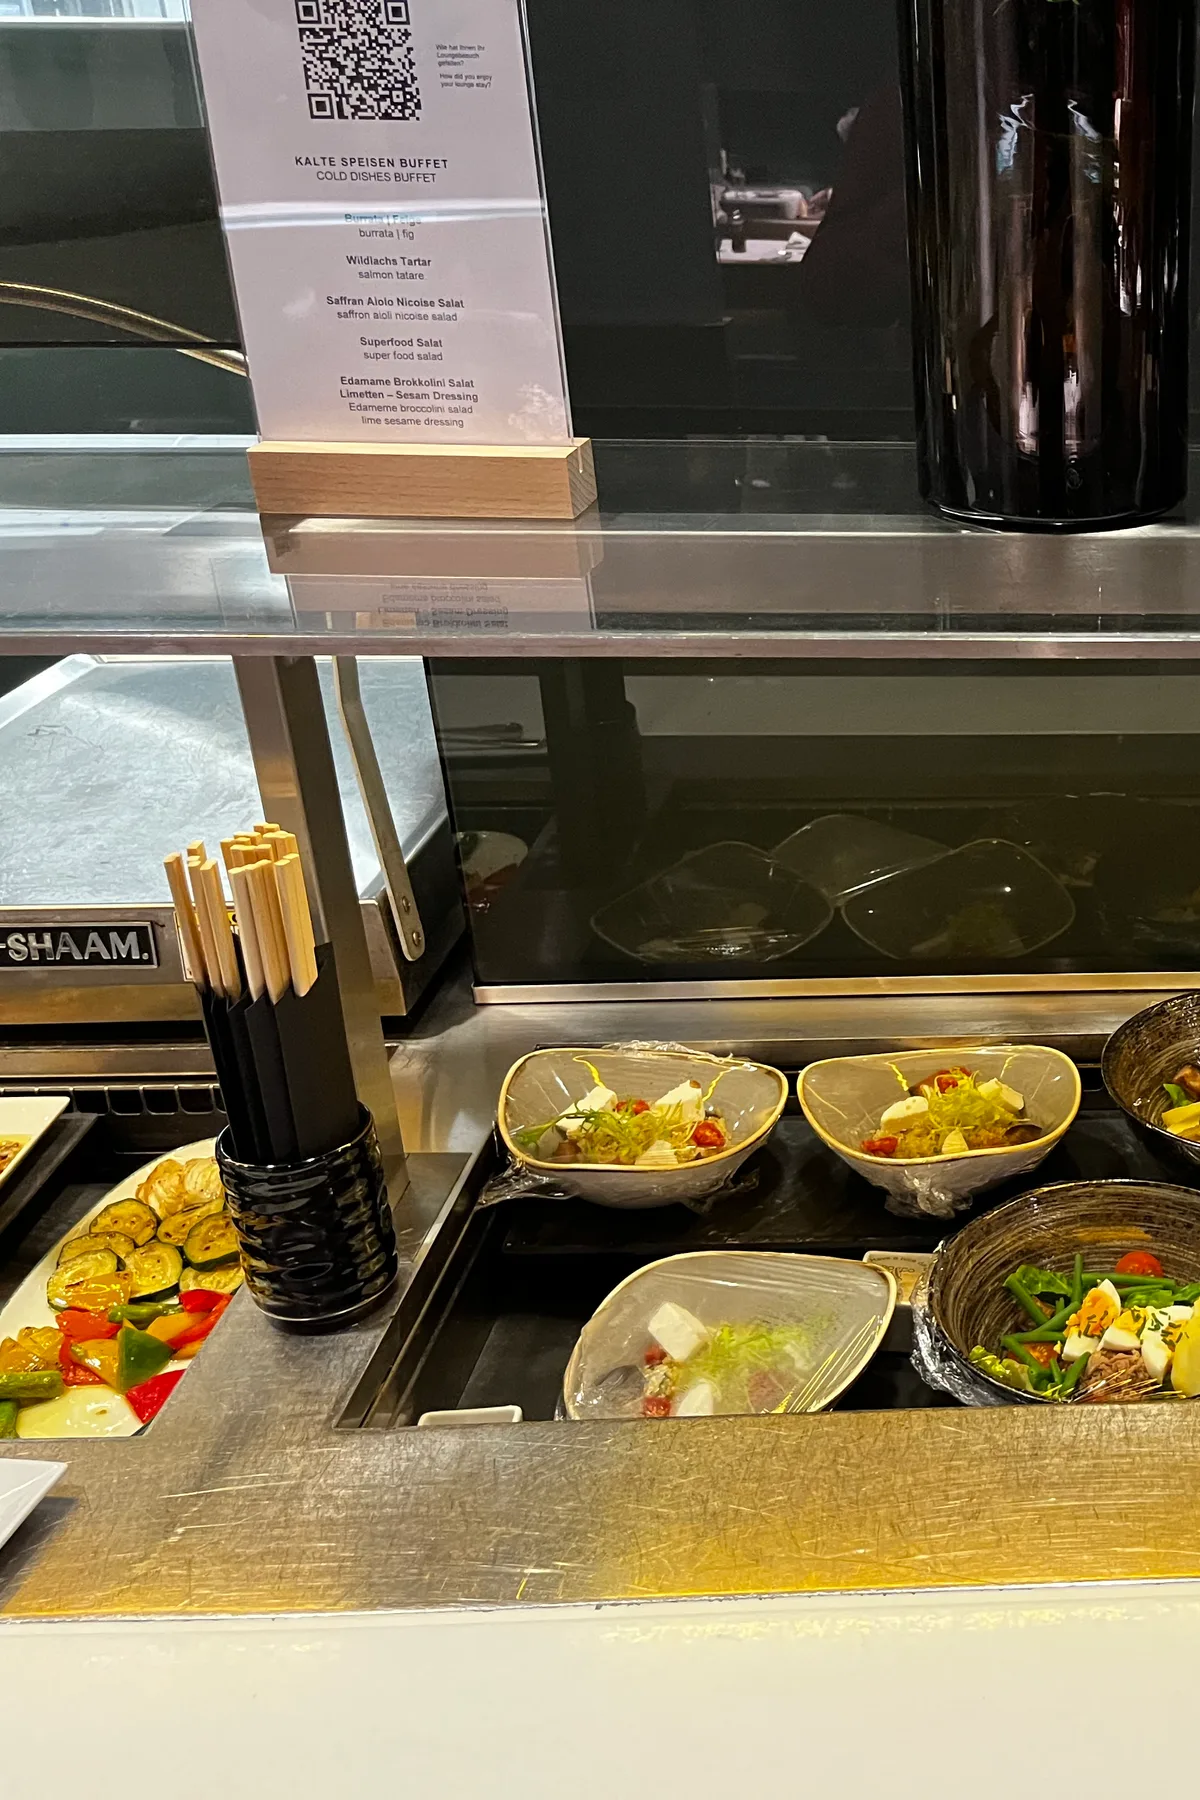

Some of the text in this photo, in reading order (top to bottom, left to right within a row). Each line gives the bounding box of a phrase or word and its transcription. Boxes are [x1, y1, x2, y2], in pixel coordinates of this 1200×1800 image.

[295, 156, 448, 169] KALTE SPEISEN BUFFET
[316, 171, 436, 183] COLD DISHES BUFFET
[359, 228, 394, 238] burrata
[403, 229, 414, 240] fig
[346, 255, 432, 267] Wildlachs Tartar
[358, 270, 425, 280] salmon tatare
[326, 296, 465, 308] Saffran Aiolo Nicoise Salat
[337, 310, 458, 321] saffron aioli nicoise salad
[360, 336, 443, 348] Superfood Salat
[363, 351, 443, 362] super food salad
[340, 376, 475, 388] Edamame Brokkolini Salat
[339, 389, 385, 399] Limetten
[395, 390, 431, 400] Sesam
[432, 391, 479, 403] Dressing
[348, 402, 474, 414] Edameme broccolini salad
[361, 416, 465, 429] lime sesame dressing
